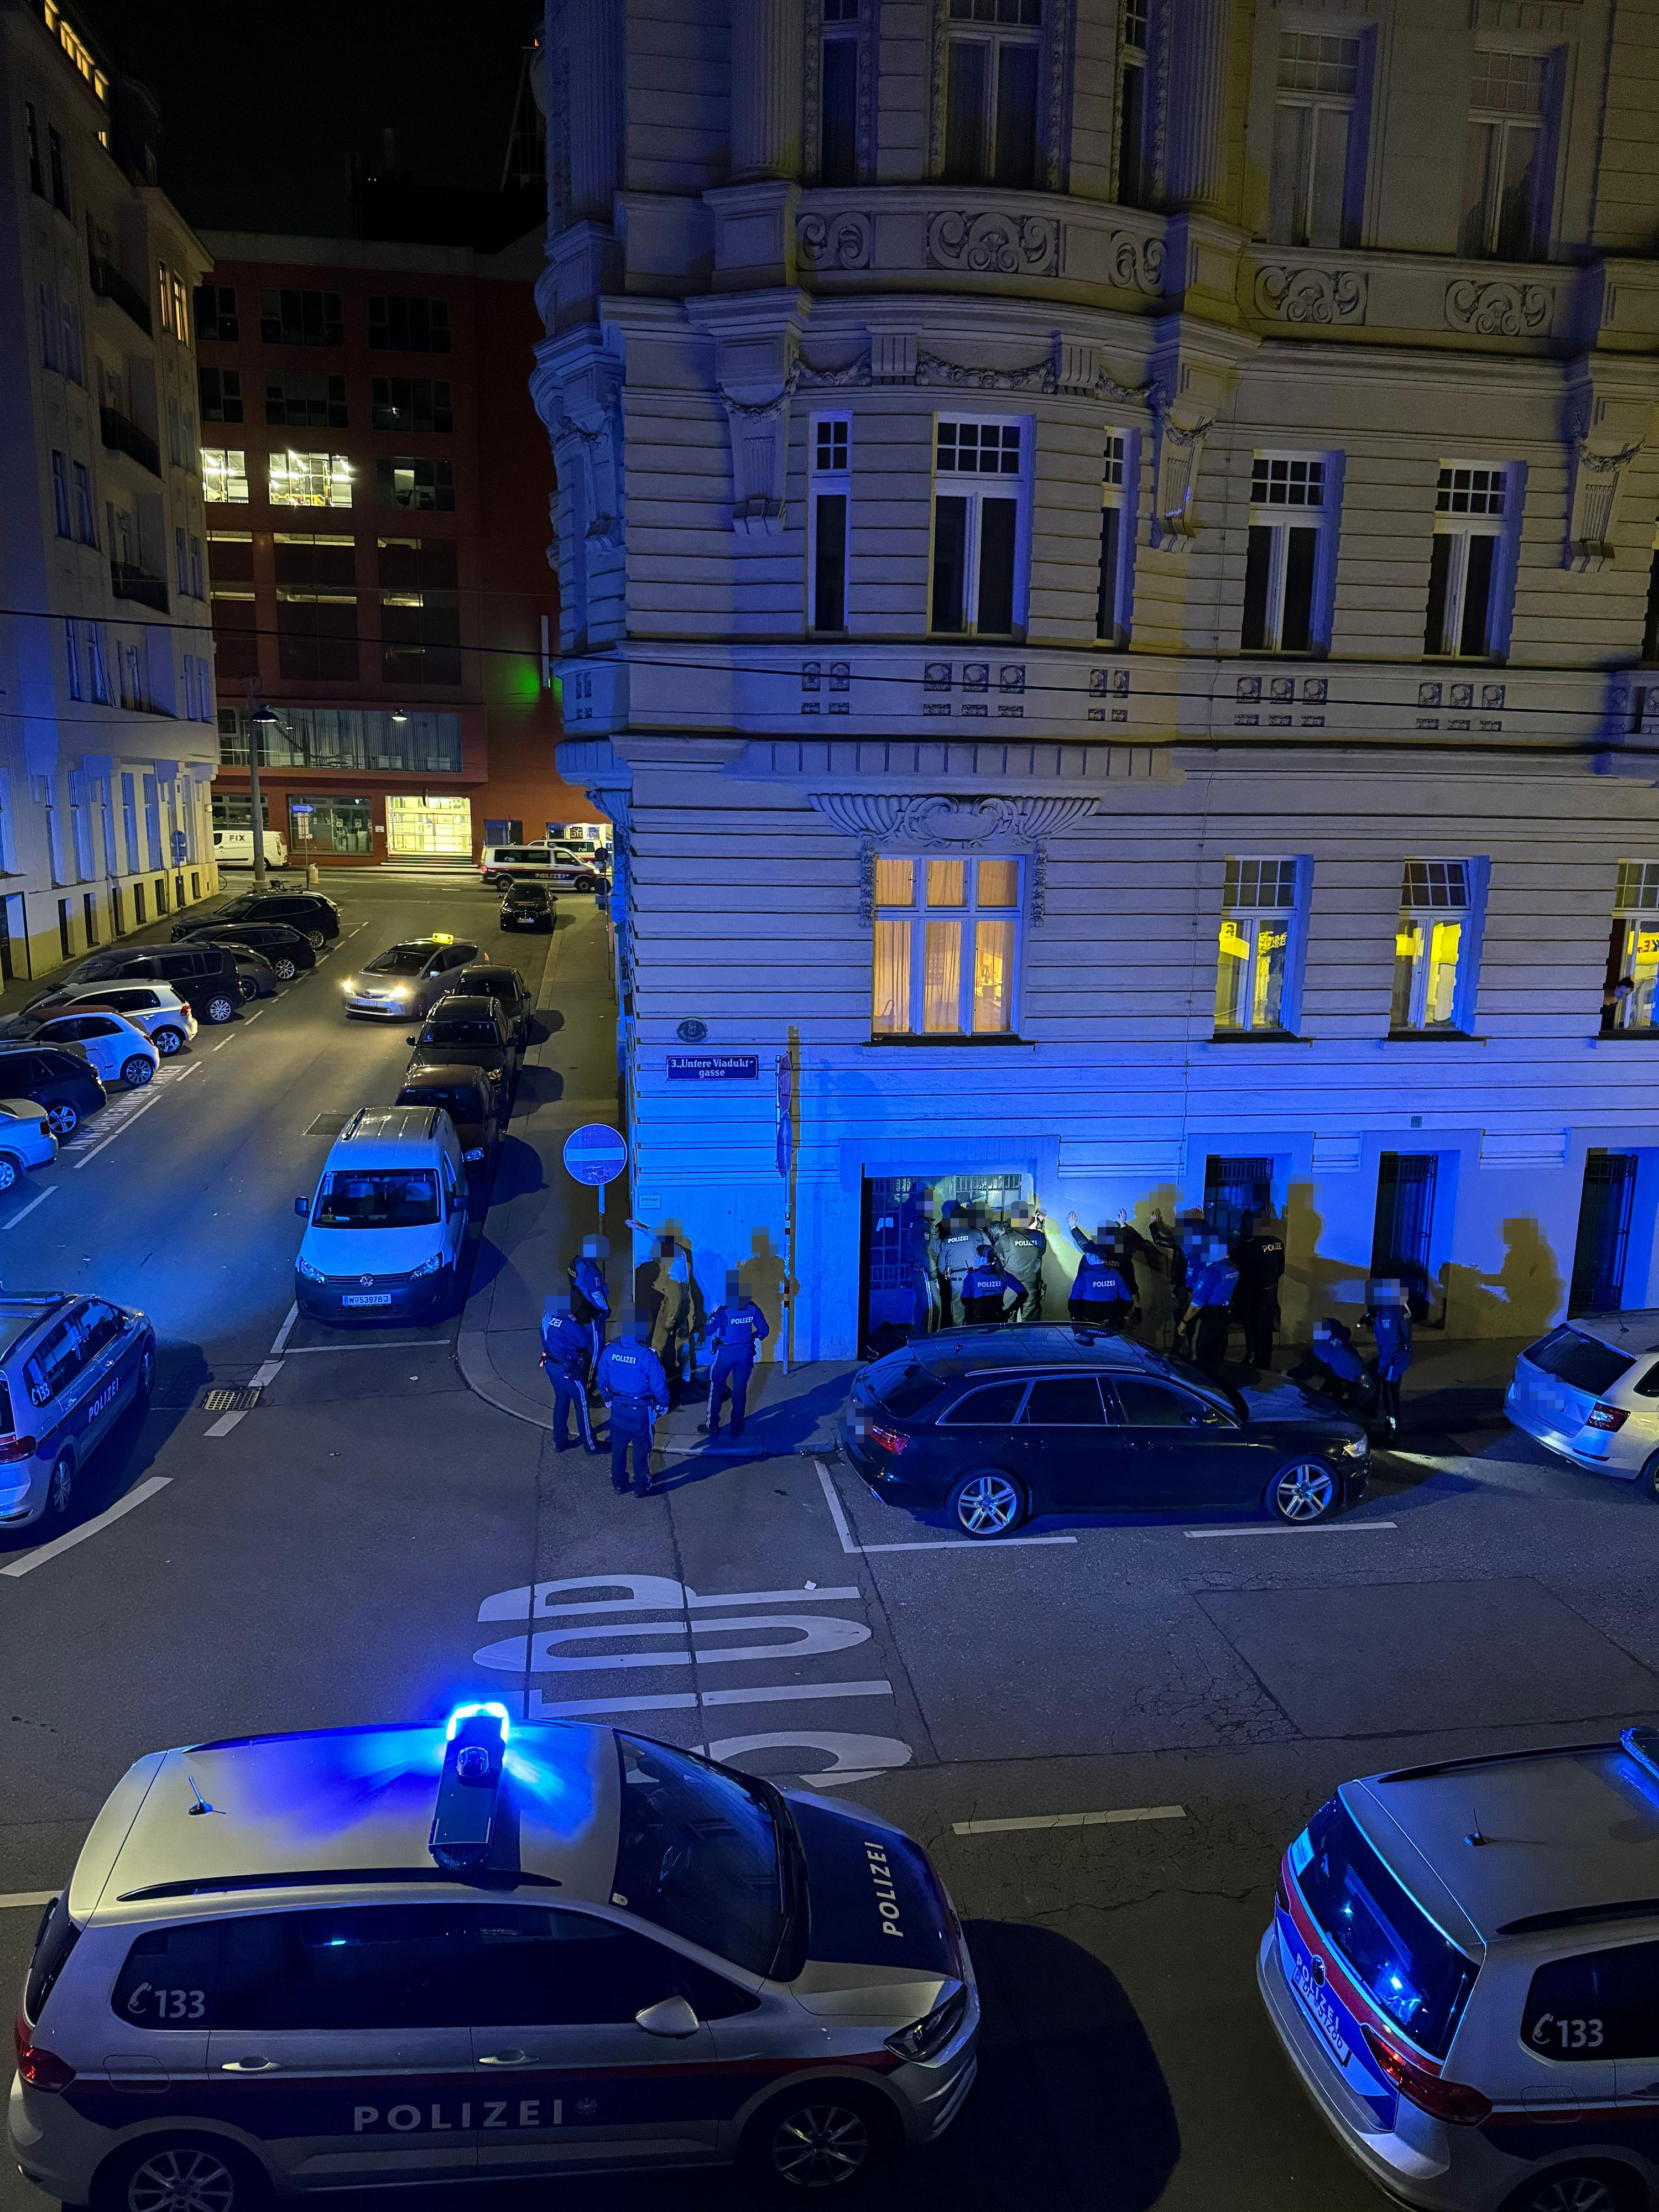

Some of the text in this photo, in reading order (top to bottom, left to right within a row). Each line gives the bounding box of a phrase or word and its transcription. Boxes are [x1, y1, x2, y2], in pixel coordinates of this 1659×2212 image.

[699, 1069, 725, 1078] gasse
[948, 1235, 969, 1244] POLIZEI
[731, 1316, 753, 1324] POLIZEI
[612, 1354, 636, 1364] POLIZEI
[36, 1383, 50, 1401] 133
[88, 1377, 118, 1423] POLIZEI
[864, 1841, 904, 1937] POLIZEI
[154, 1990, 205, 2018] 133
[1296, 1953, 1339, 2032] POLIZEI
[1557, 2019, 1603, 2047] 133
[354, 2099, 562, 2132] POLIZEI
